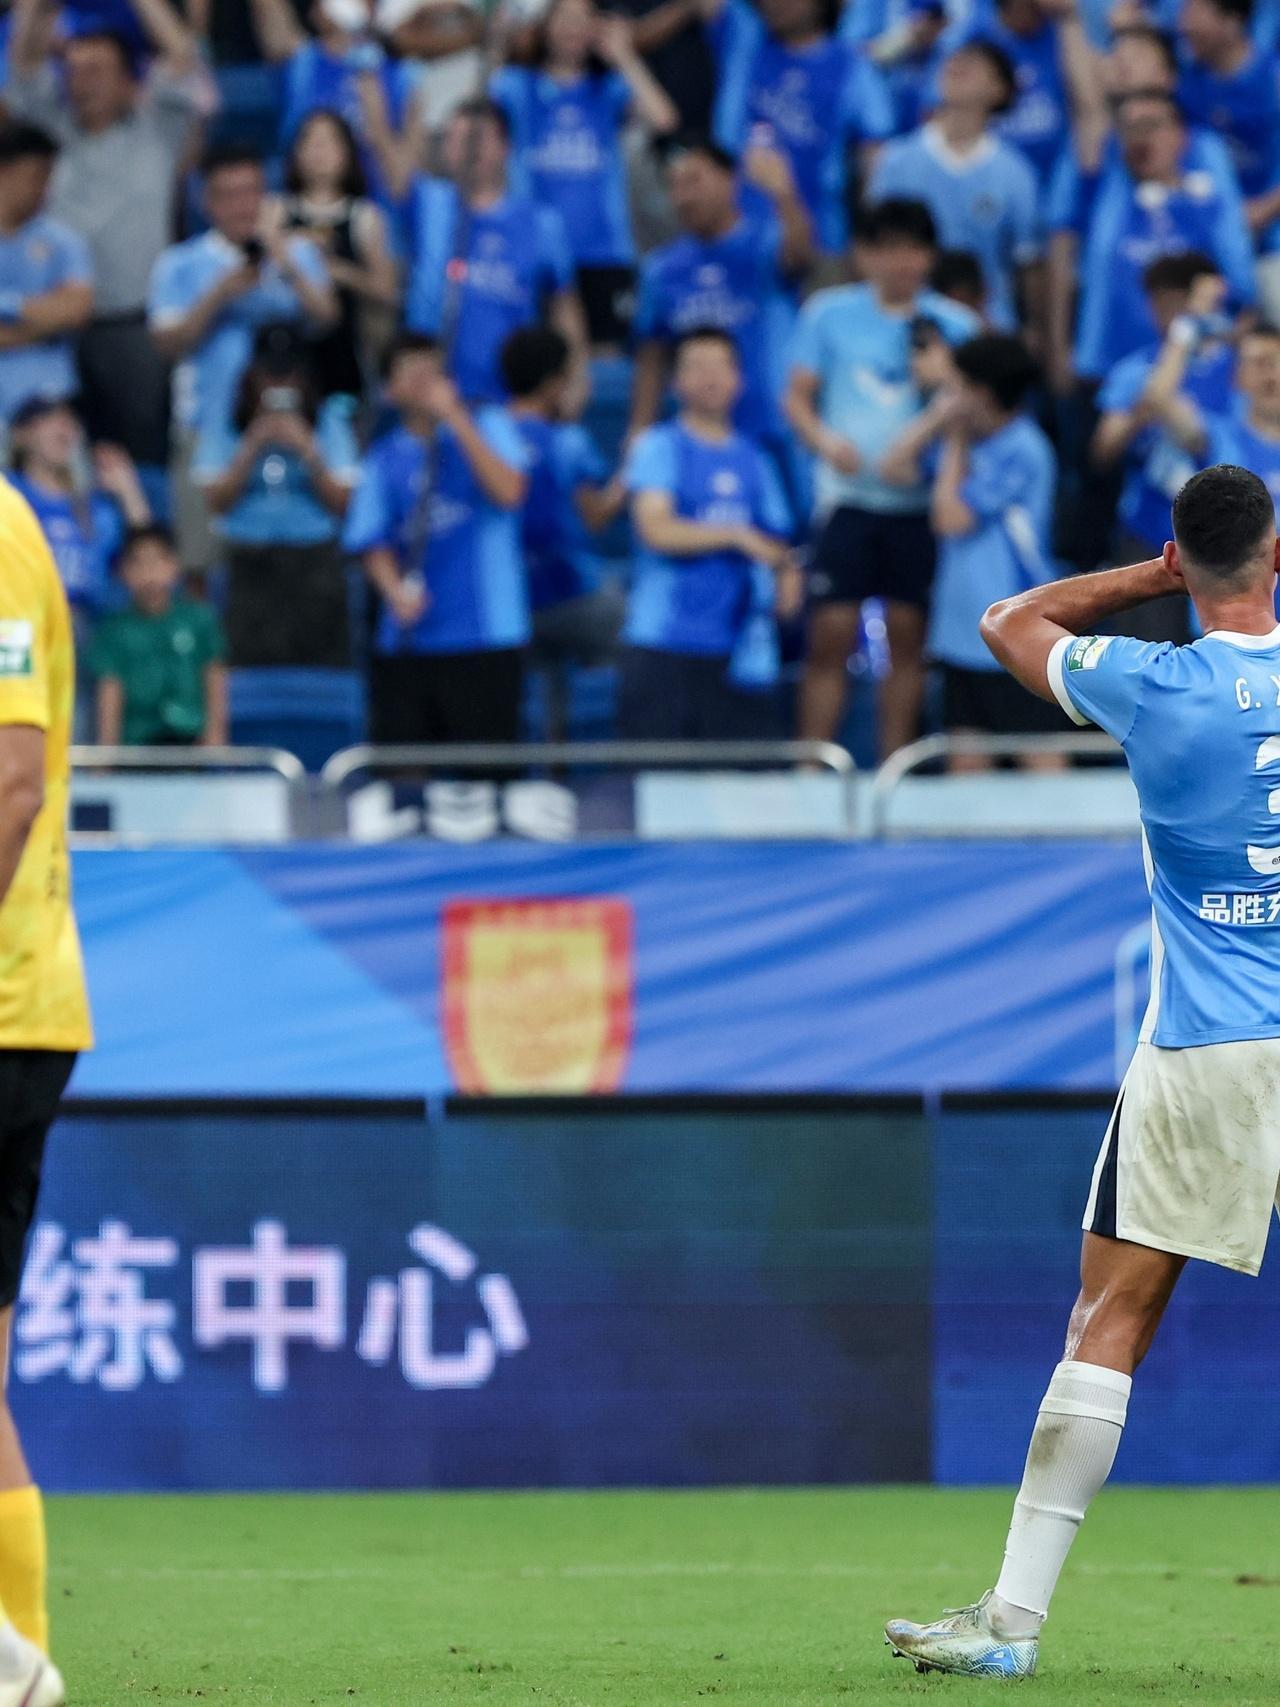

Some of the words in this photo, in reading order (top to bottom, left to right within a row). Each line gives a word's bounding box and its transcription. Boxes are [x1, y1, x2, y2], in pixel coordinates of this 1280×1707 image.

[1235, 677, 1262, 710] G.
[14, 1218, 530, 1393] 练中心
